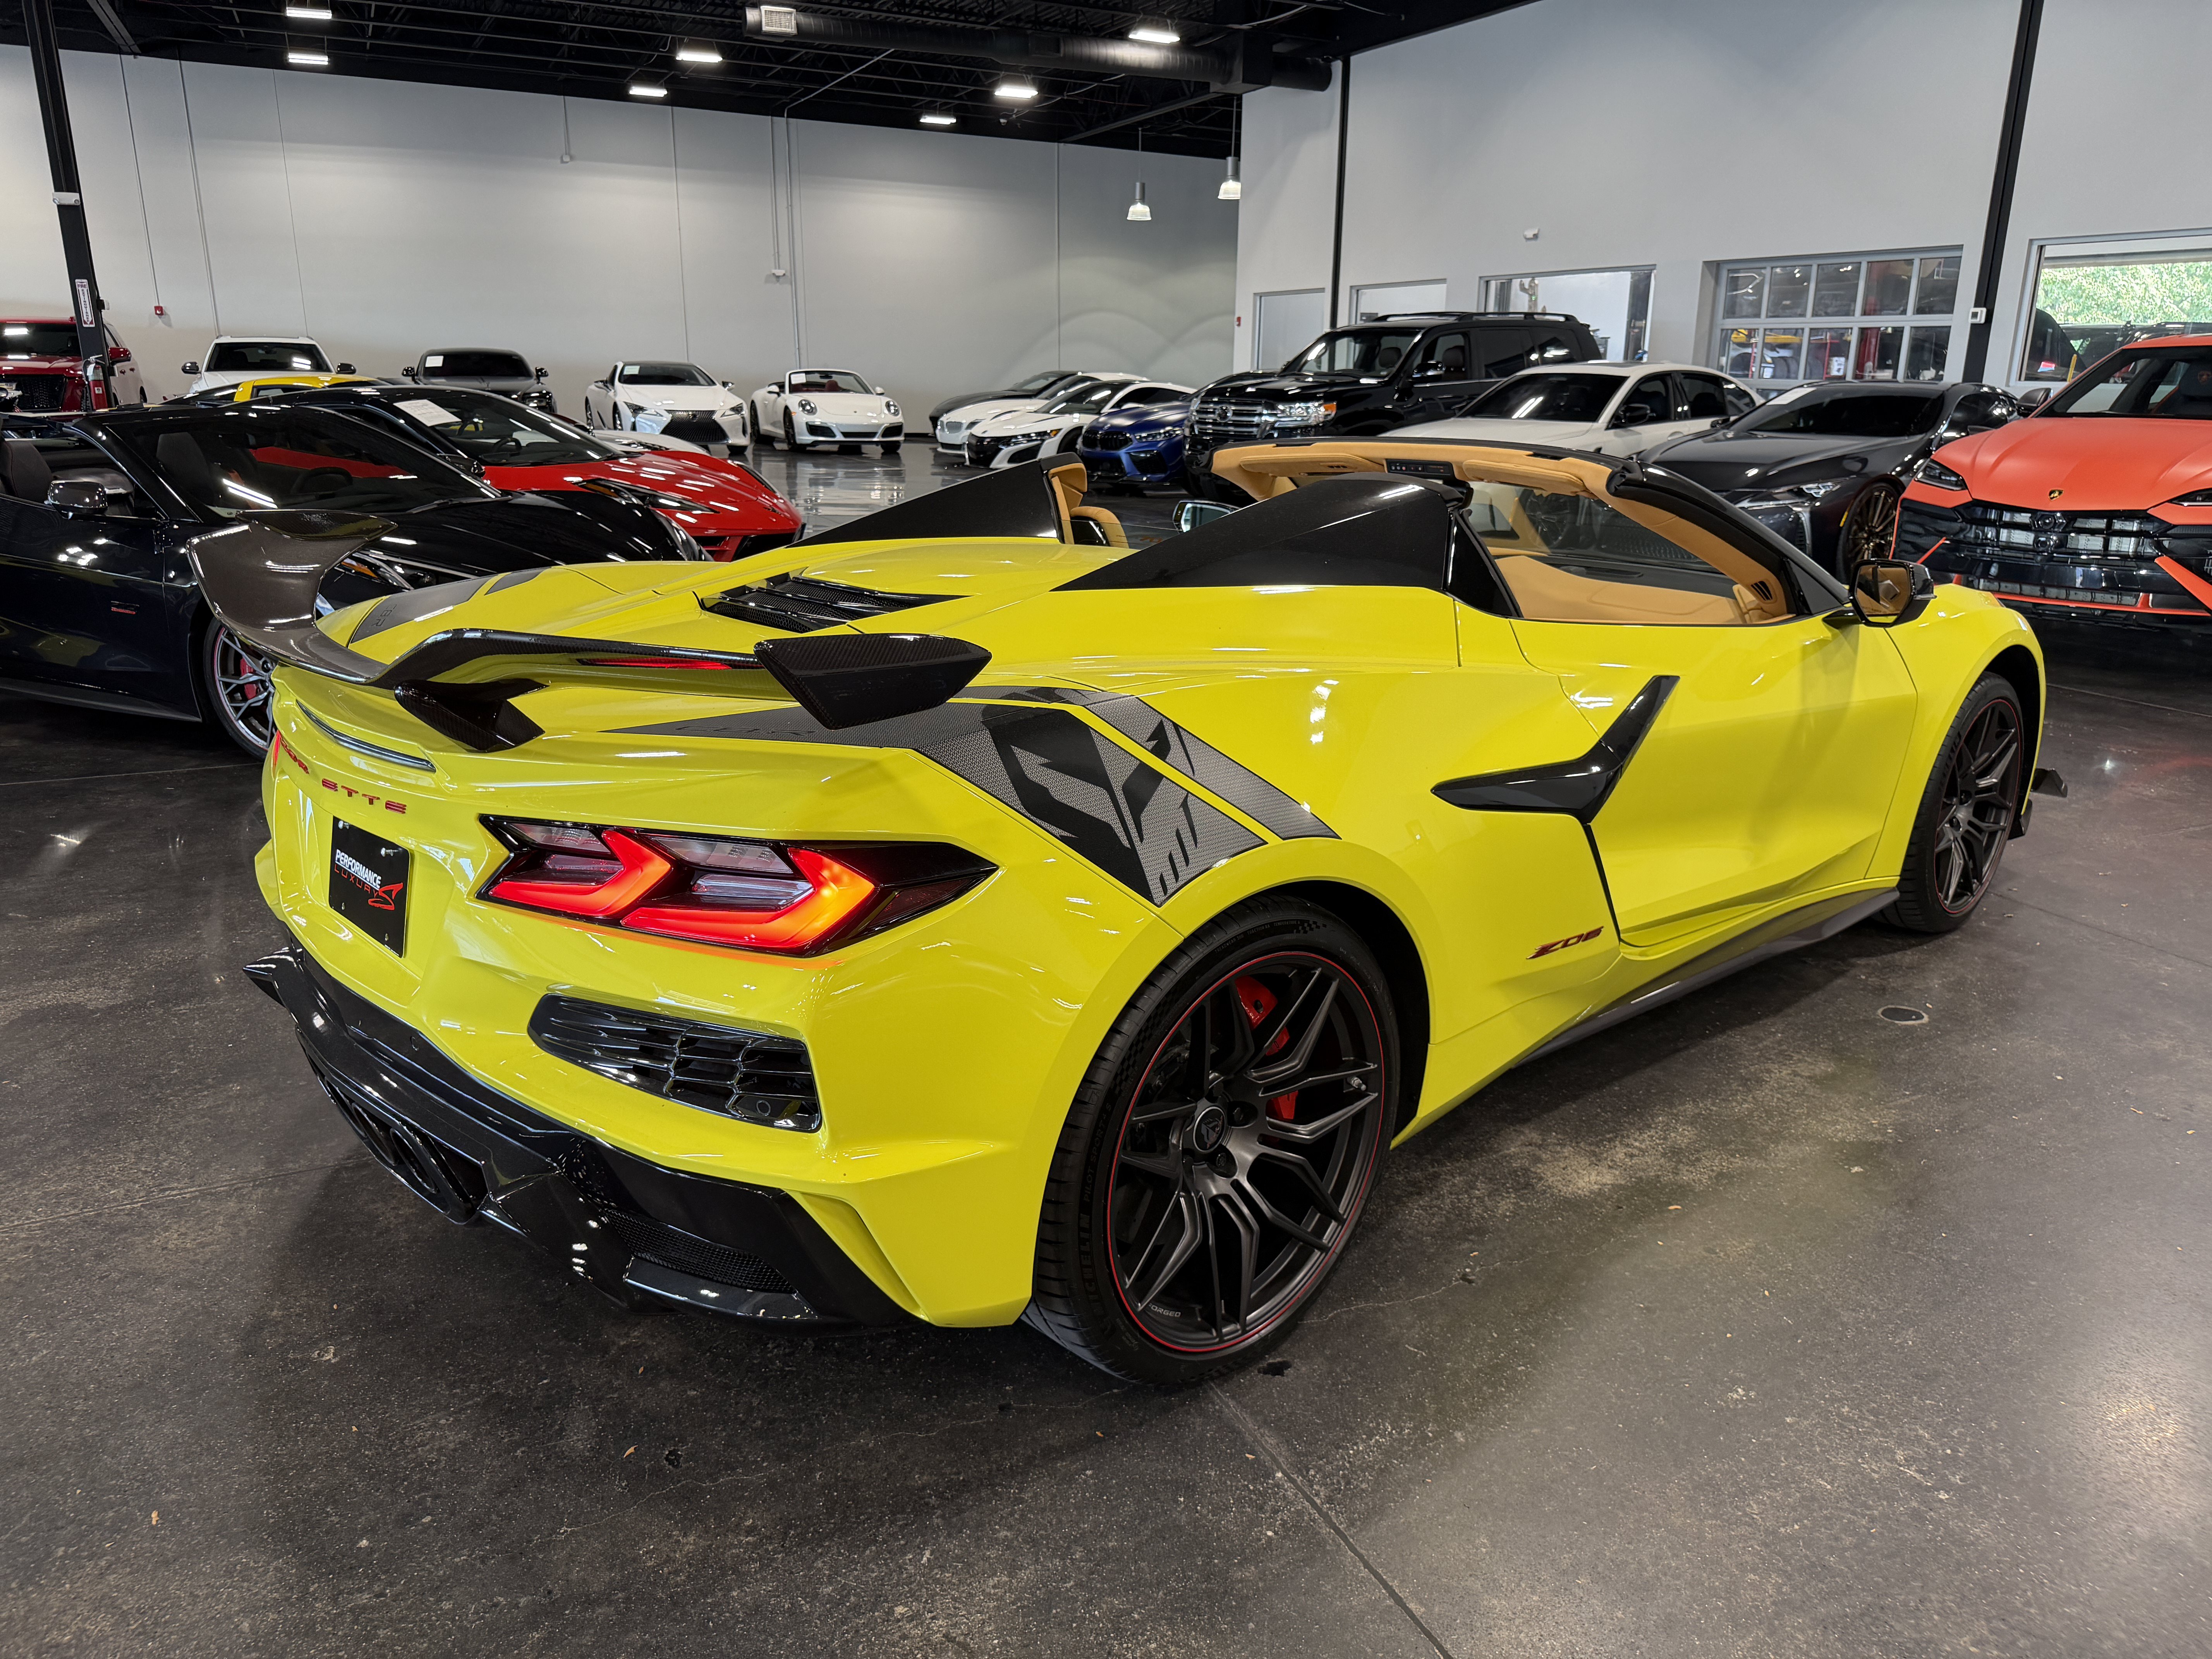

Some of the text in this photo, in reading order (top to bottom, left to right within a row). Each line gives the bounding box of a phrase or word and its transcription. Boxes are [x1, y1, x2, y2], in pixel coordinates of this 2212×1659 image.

[335, 849, 381, 888] PERFORMANCE
[335, 864, 378, 898] LUXURY
[1526, 926, 1604, 960] Z06
[1084, 1166, 1094, 1202] PILOT
[1091, 1120, 1103, 1162] SPORT
